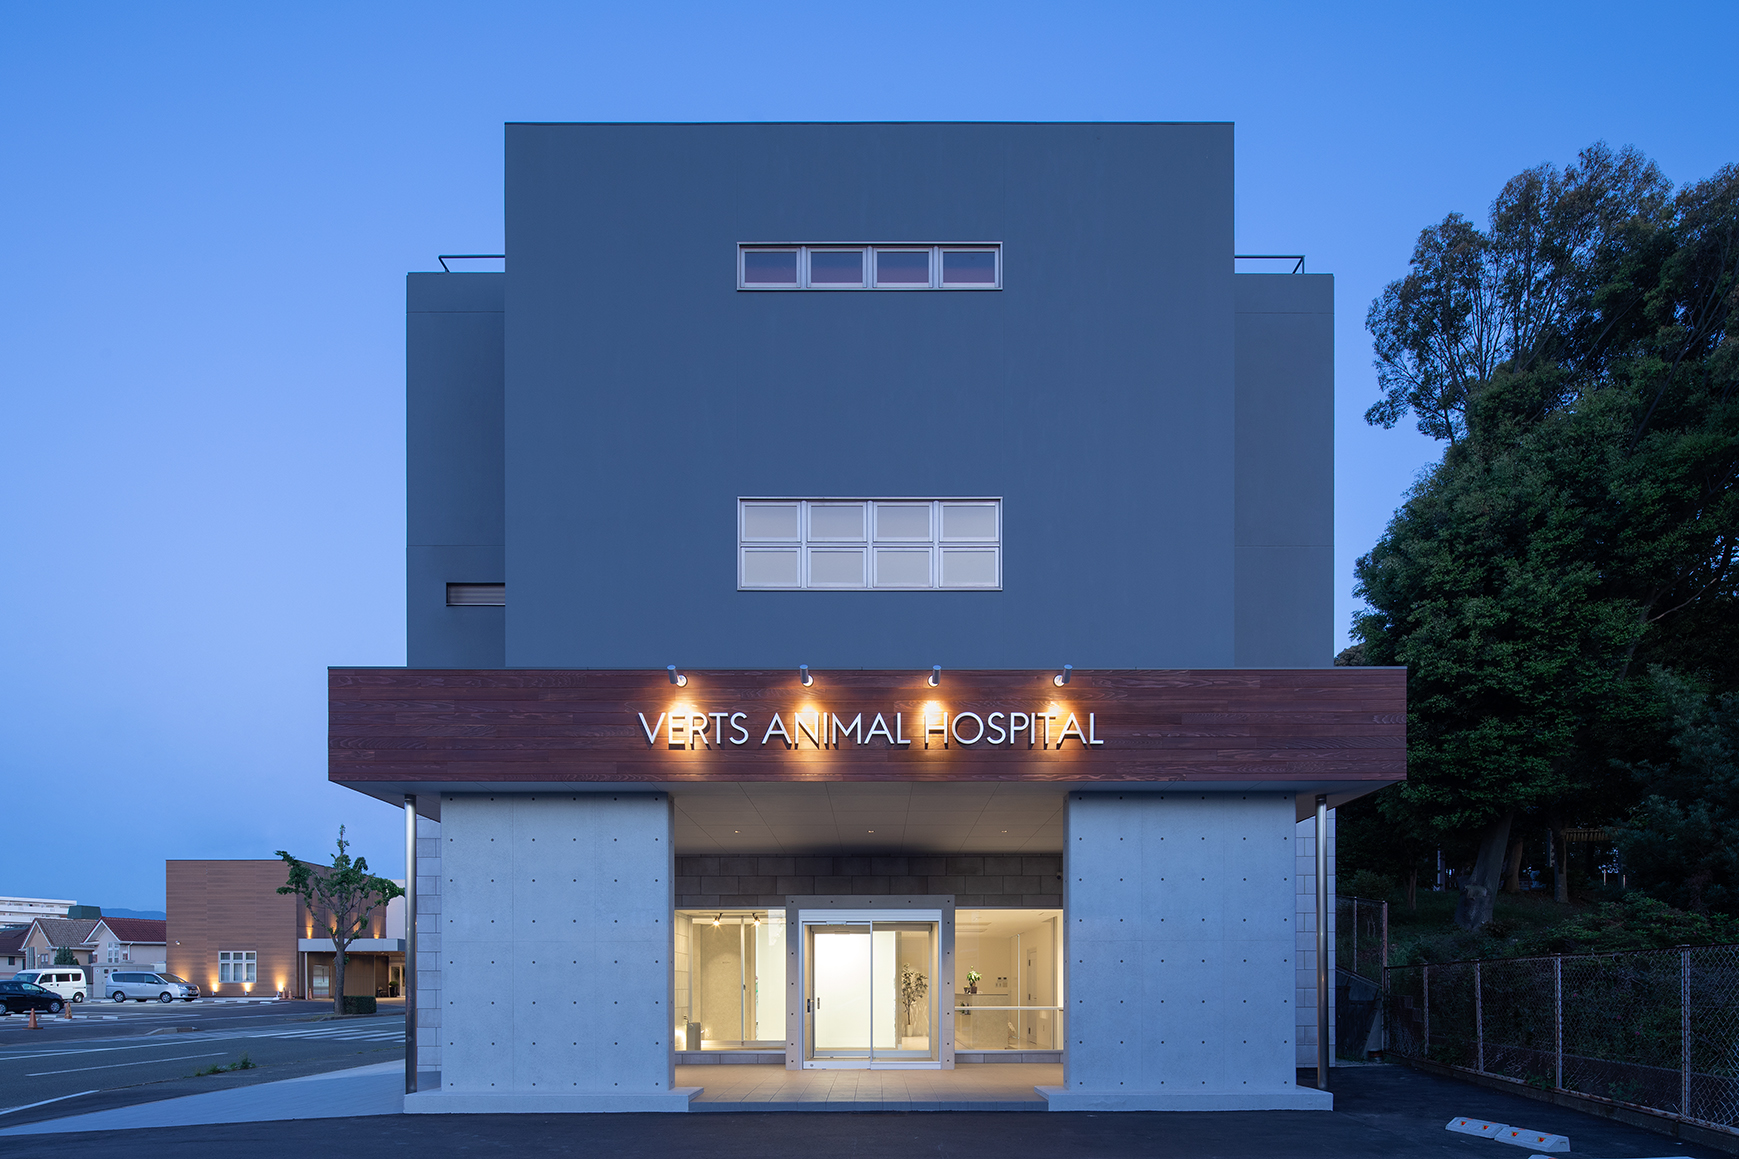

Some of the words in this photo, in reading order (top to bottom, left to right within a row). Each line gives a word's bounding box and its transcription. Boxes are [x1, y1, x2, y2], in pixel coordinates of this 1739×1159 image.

[638, 711, 749, 746] VERTS
[761, 711, 911, 746] ANIMAL
[924, 711, 1105, 746] HOSPITAL
